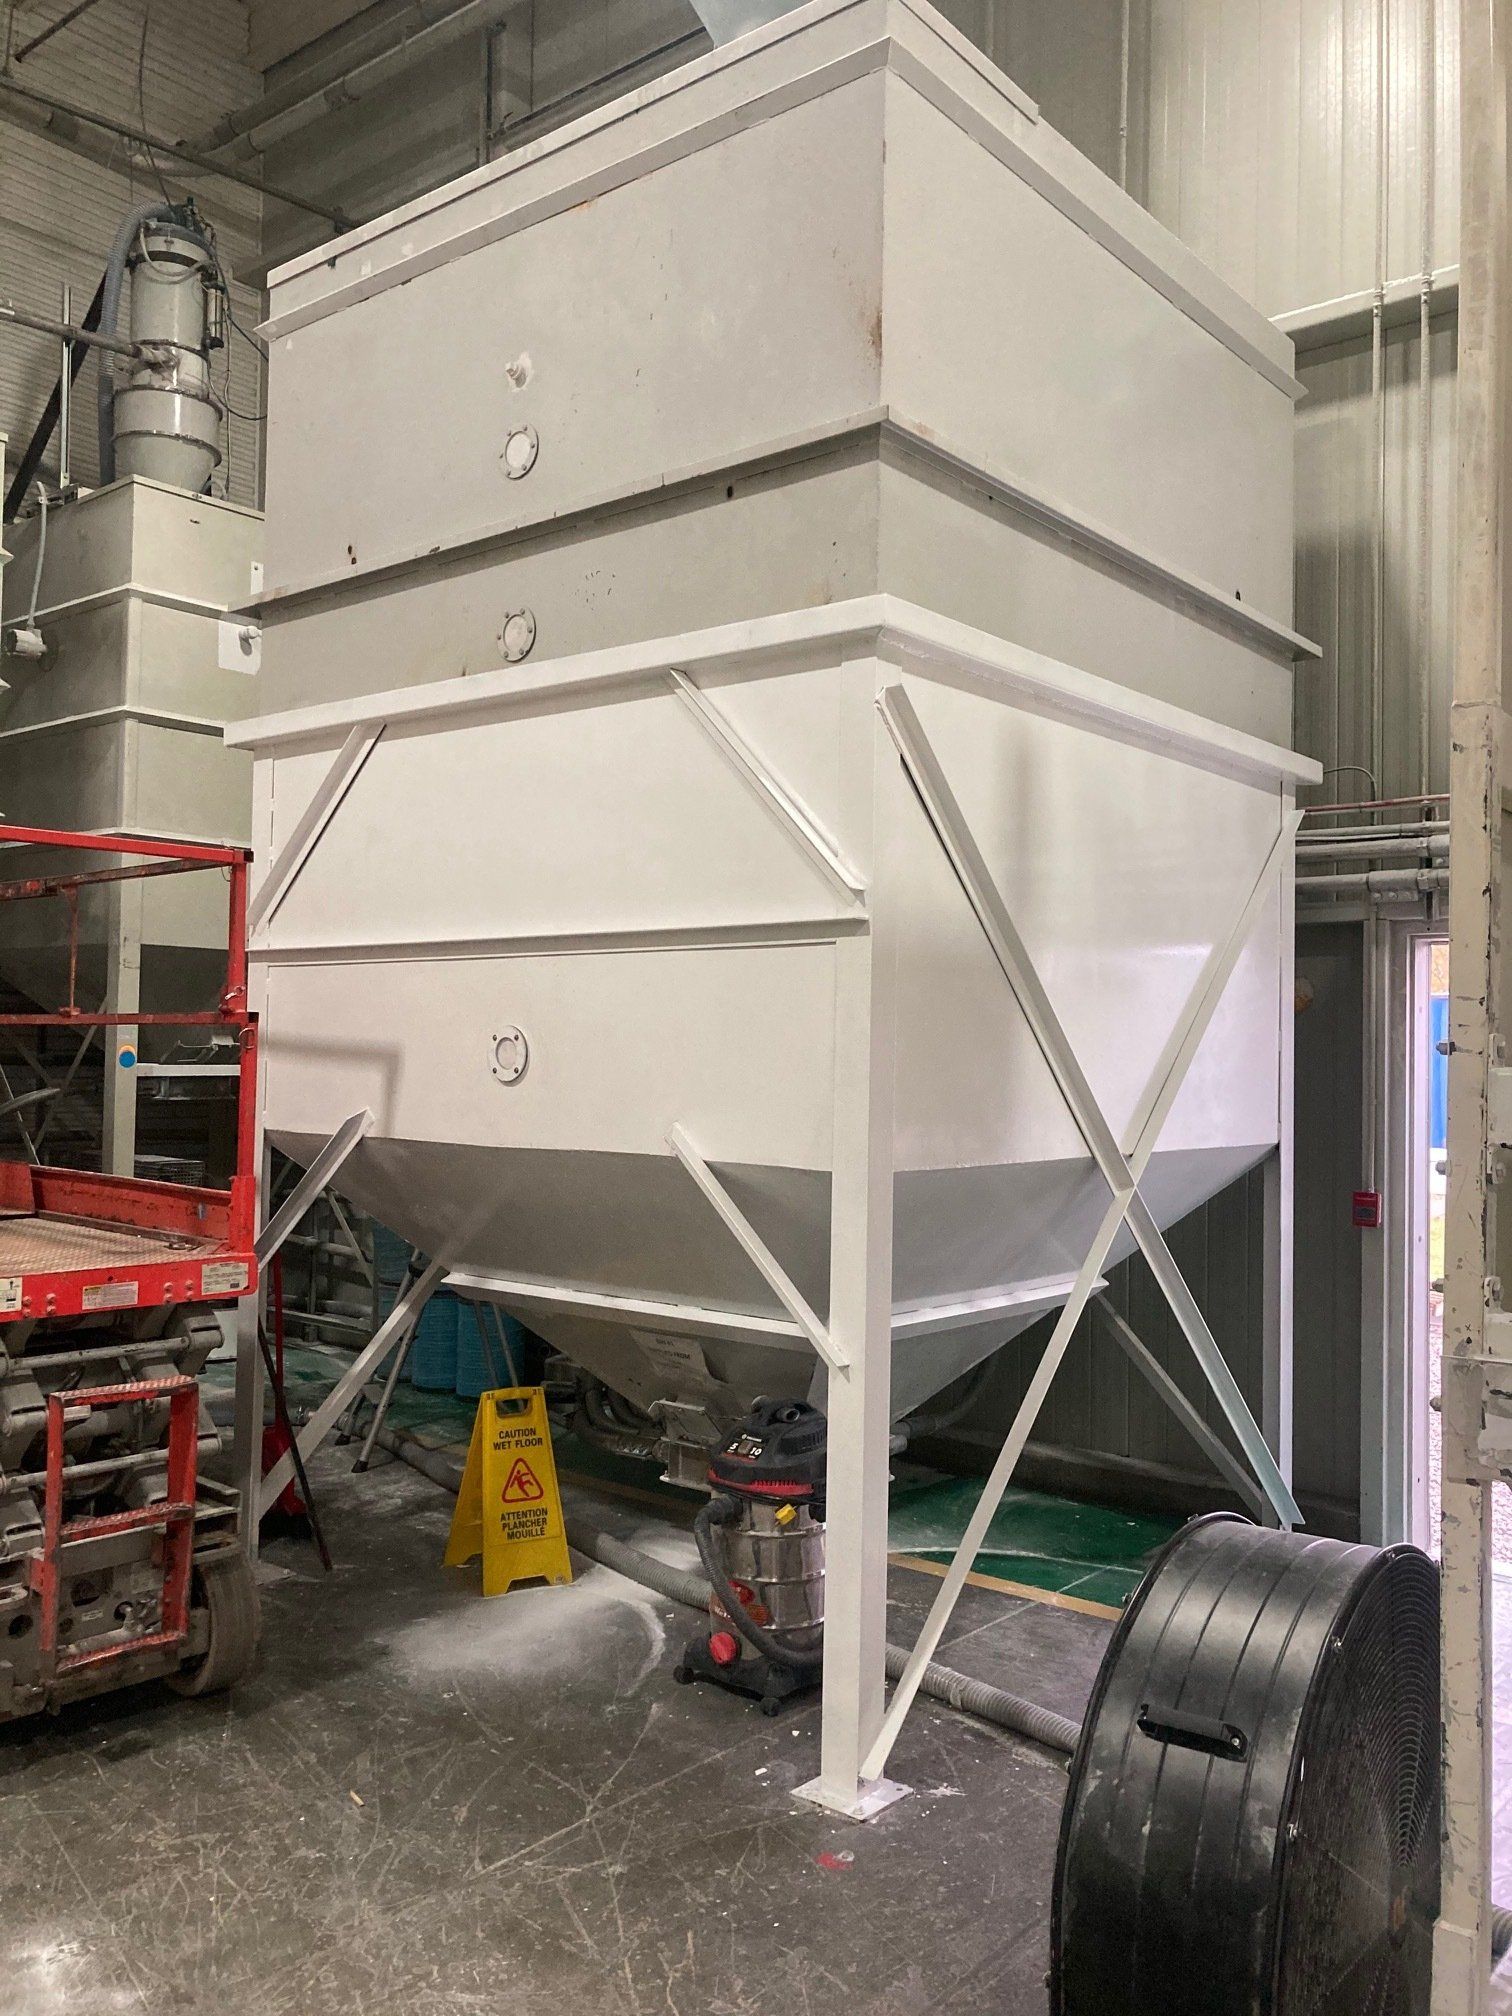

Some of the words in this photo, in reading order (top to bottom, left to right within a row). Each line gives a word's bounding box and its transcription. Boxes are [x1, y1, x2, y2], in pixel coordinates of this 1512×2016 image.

[498, 1427, 537, 1440] CAUTION
[493, 1439, 512, 1451] WET
[515, 1437, 543, 1448] FLOOR
[500, 1507, 548, 1522] ATTENTION
[501, 1517, 547, 1531] PLANCHER
[506, 1525, 546, 1540] MOUILLÉ
